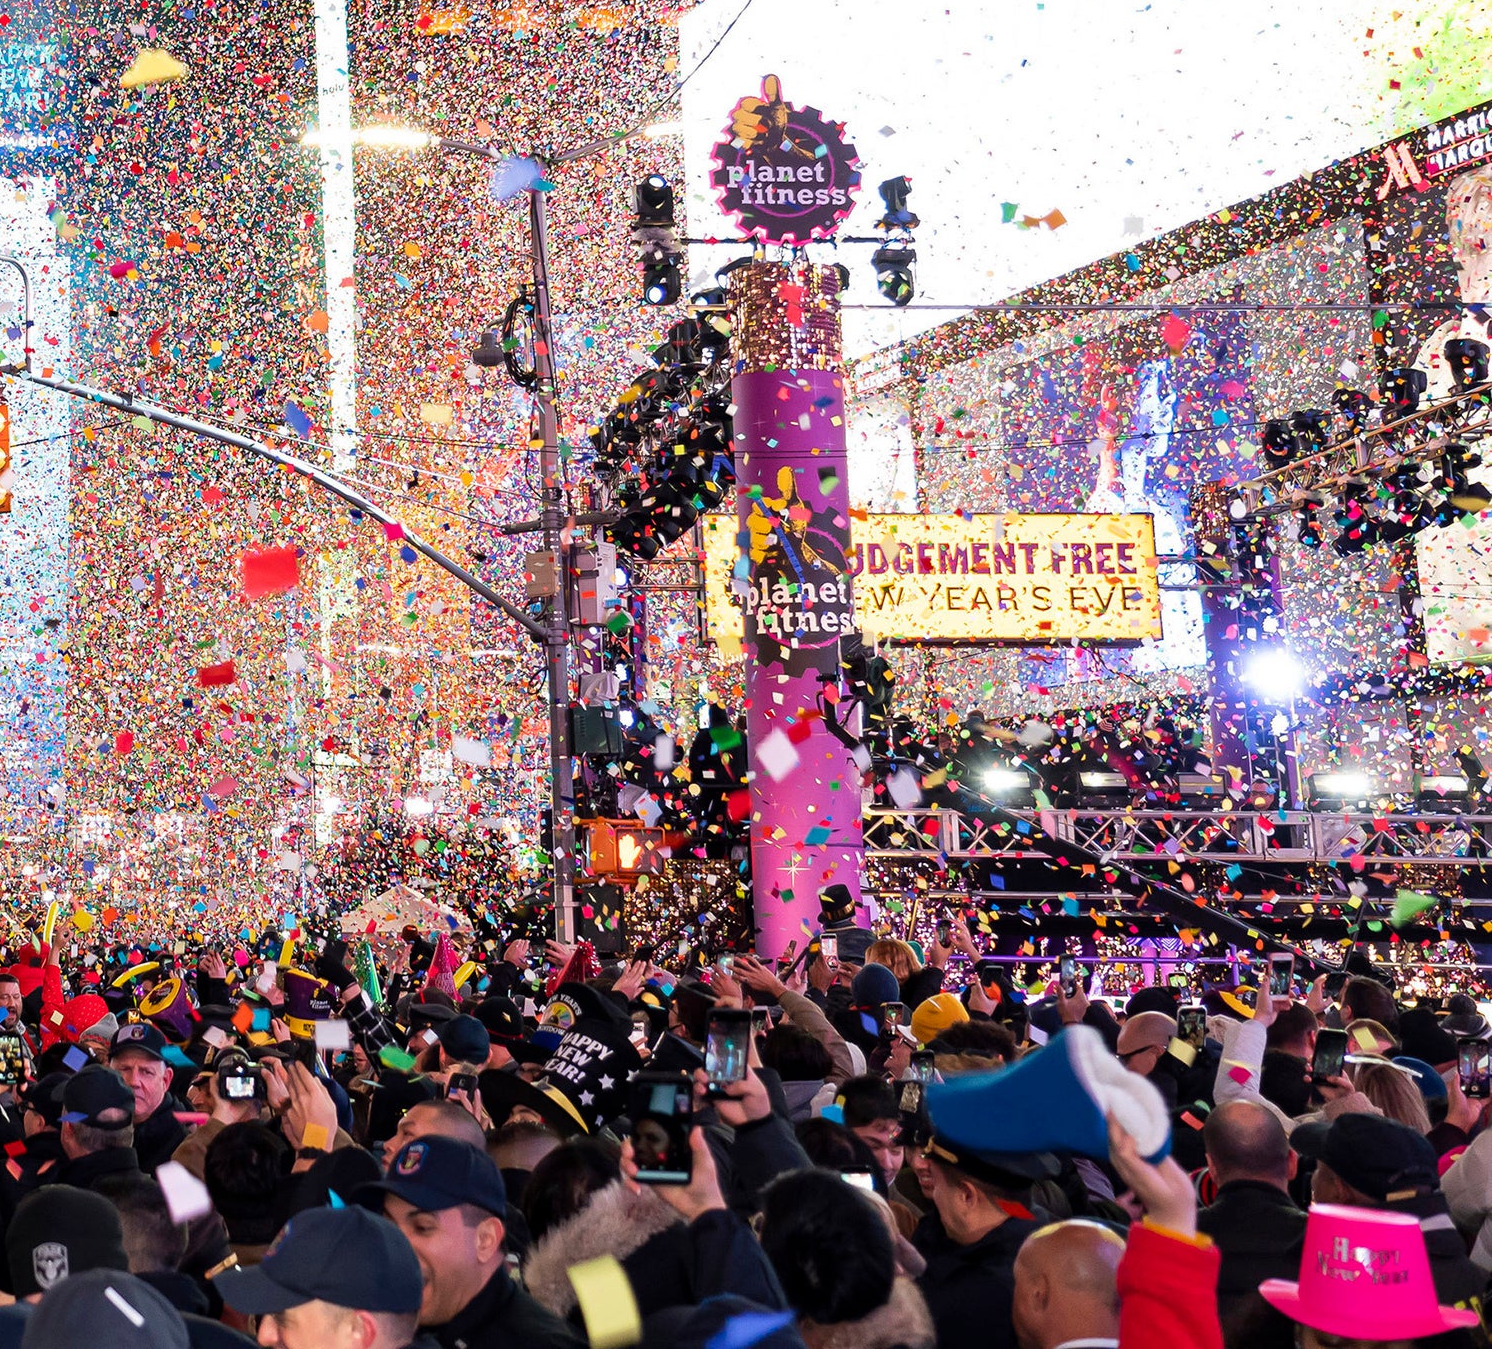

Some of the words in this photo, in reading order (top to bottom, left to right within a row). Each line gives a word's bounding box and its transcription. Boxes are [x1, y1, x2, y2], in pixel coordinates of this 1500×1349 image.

[726, 159, 826, 194] planet
[740, 181, 847, 207] fitness
[1051, 541, 1138, 574] FREE
[746, 578, 852, 616] planet
[924, 584, 1055, 612] YEAR'S
[1069, 585, 1142, 611] EVE
[552, 1043, 594, 1068] NEW
[559, 1029, 616, 1061] HAPPY
[1330, 1235, 1400, 1269] Happy
[1316, 1254, 1363, 1284] New
[1369, 1265, 1410, 1287] Year
